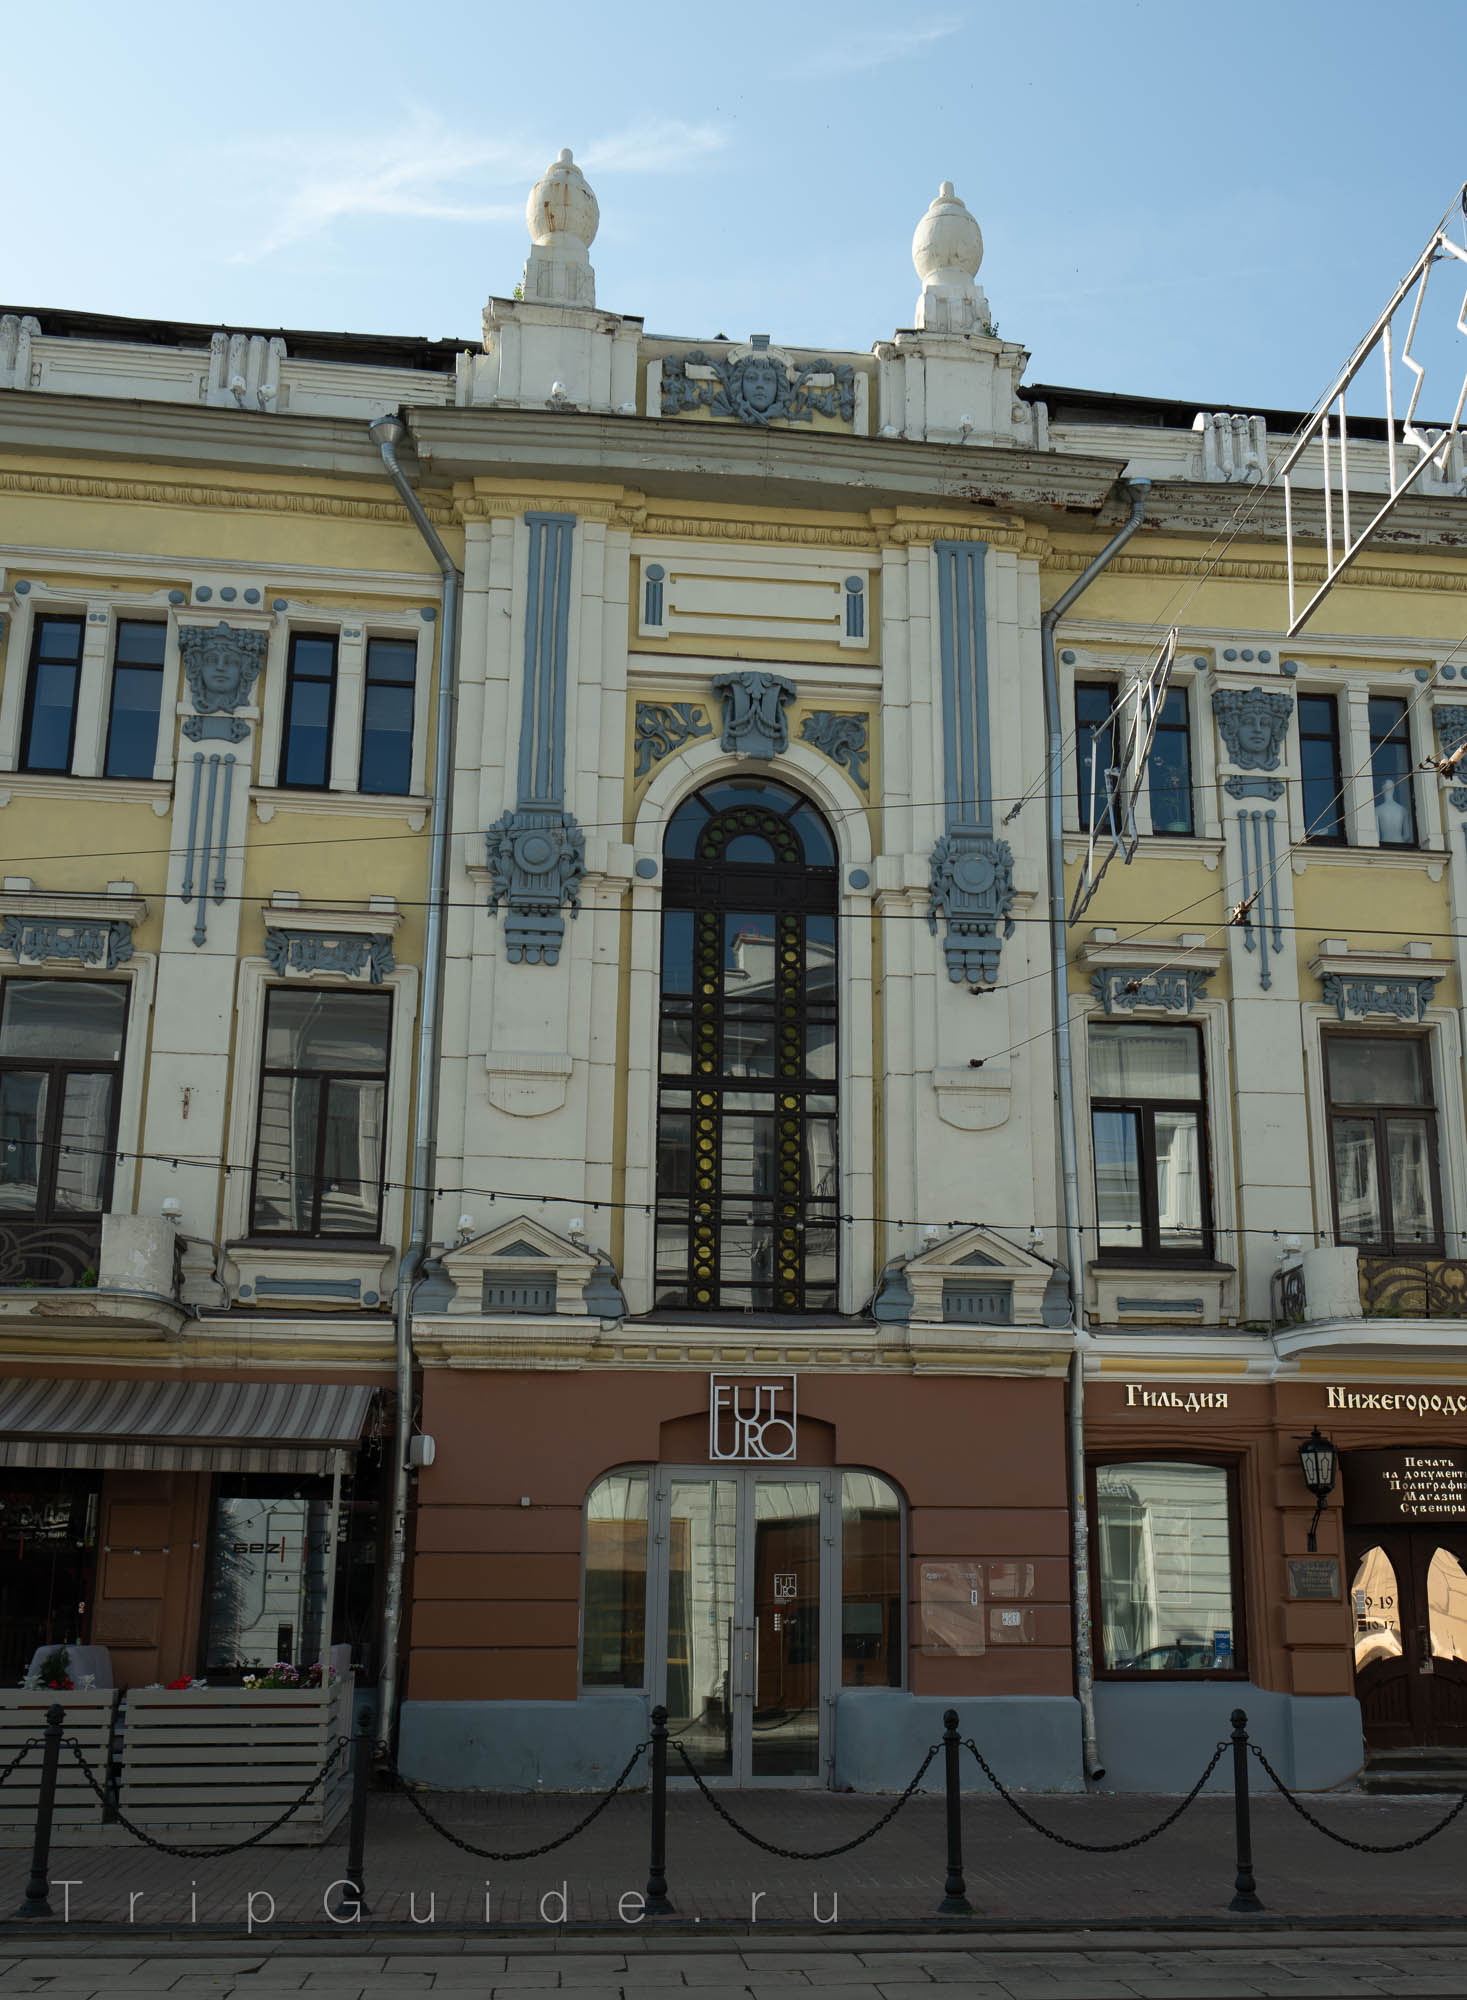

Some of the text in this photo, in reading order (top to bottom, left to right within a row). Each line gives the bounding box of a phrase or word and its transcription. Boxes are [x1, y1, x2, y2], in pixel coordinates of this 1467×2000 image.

[1125, 1384, 1228, 1413] Гильдия
[1404, 1456, 1455, 1467] Печать
[1382, 1471, 1399, 1479] на
[1402, 1491, 1462, 1501] Магазин
[1400, 1503, 1466, 1516] Сувениры
[1365, 1596, 1394, 1610] 9-19
